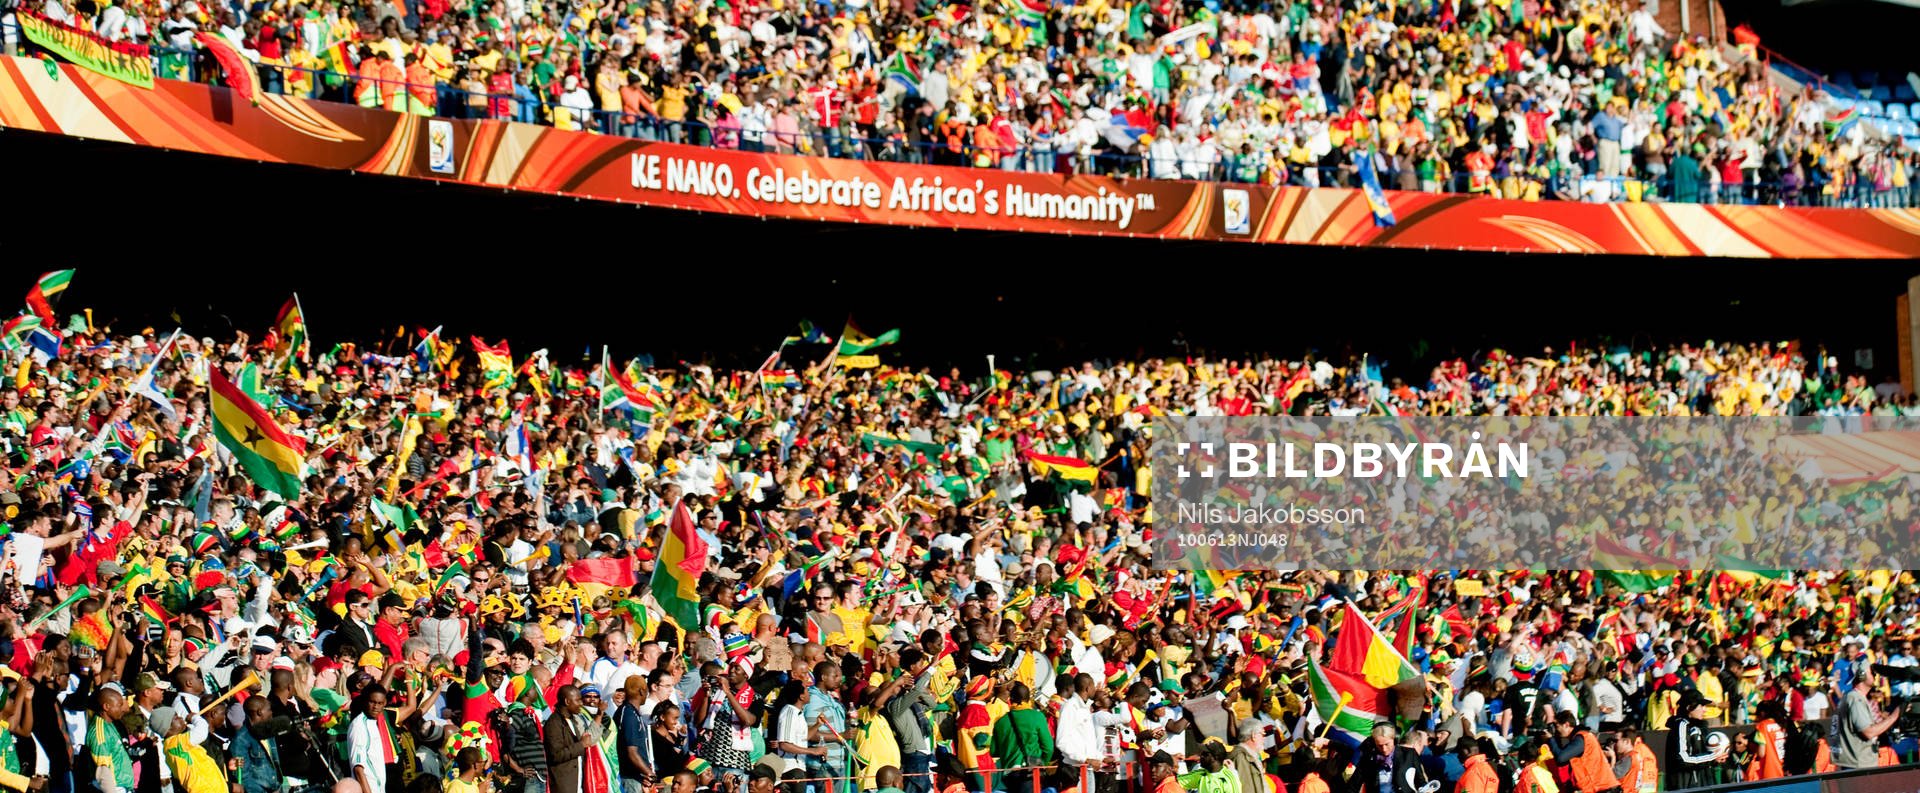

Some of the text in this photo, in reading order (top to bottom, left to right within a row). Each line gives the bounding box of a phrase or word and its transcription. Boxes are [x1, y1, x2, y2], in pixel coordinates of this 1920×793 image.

[631, 153, 662, 189] KE
[666, 158, 740, 199] NAKO.
[746, 167, 882, 208] Celebrate
[887, 176, 999, 215] Africa's
[1524, 696, 1537, 717] 7
